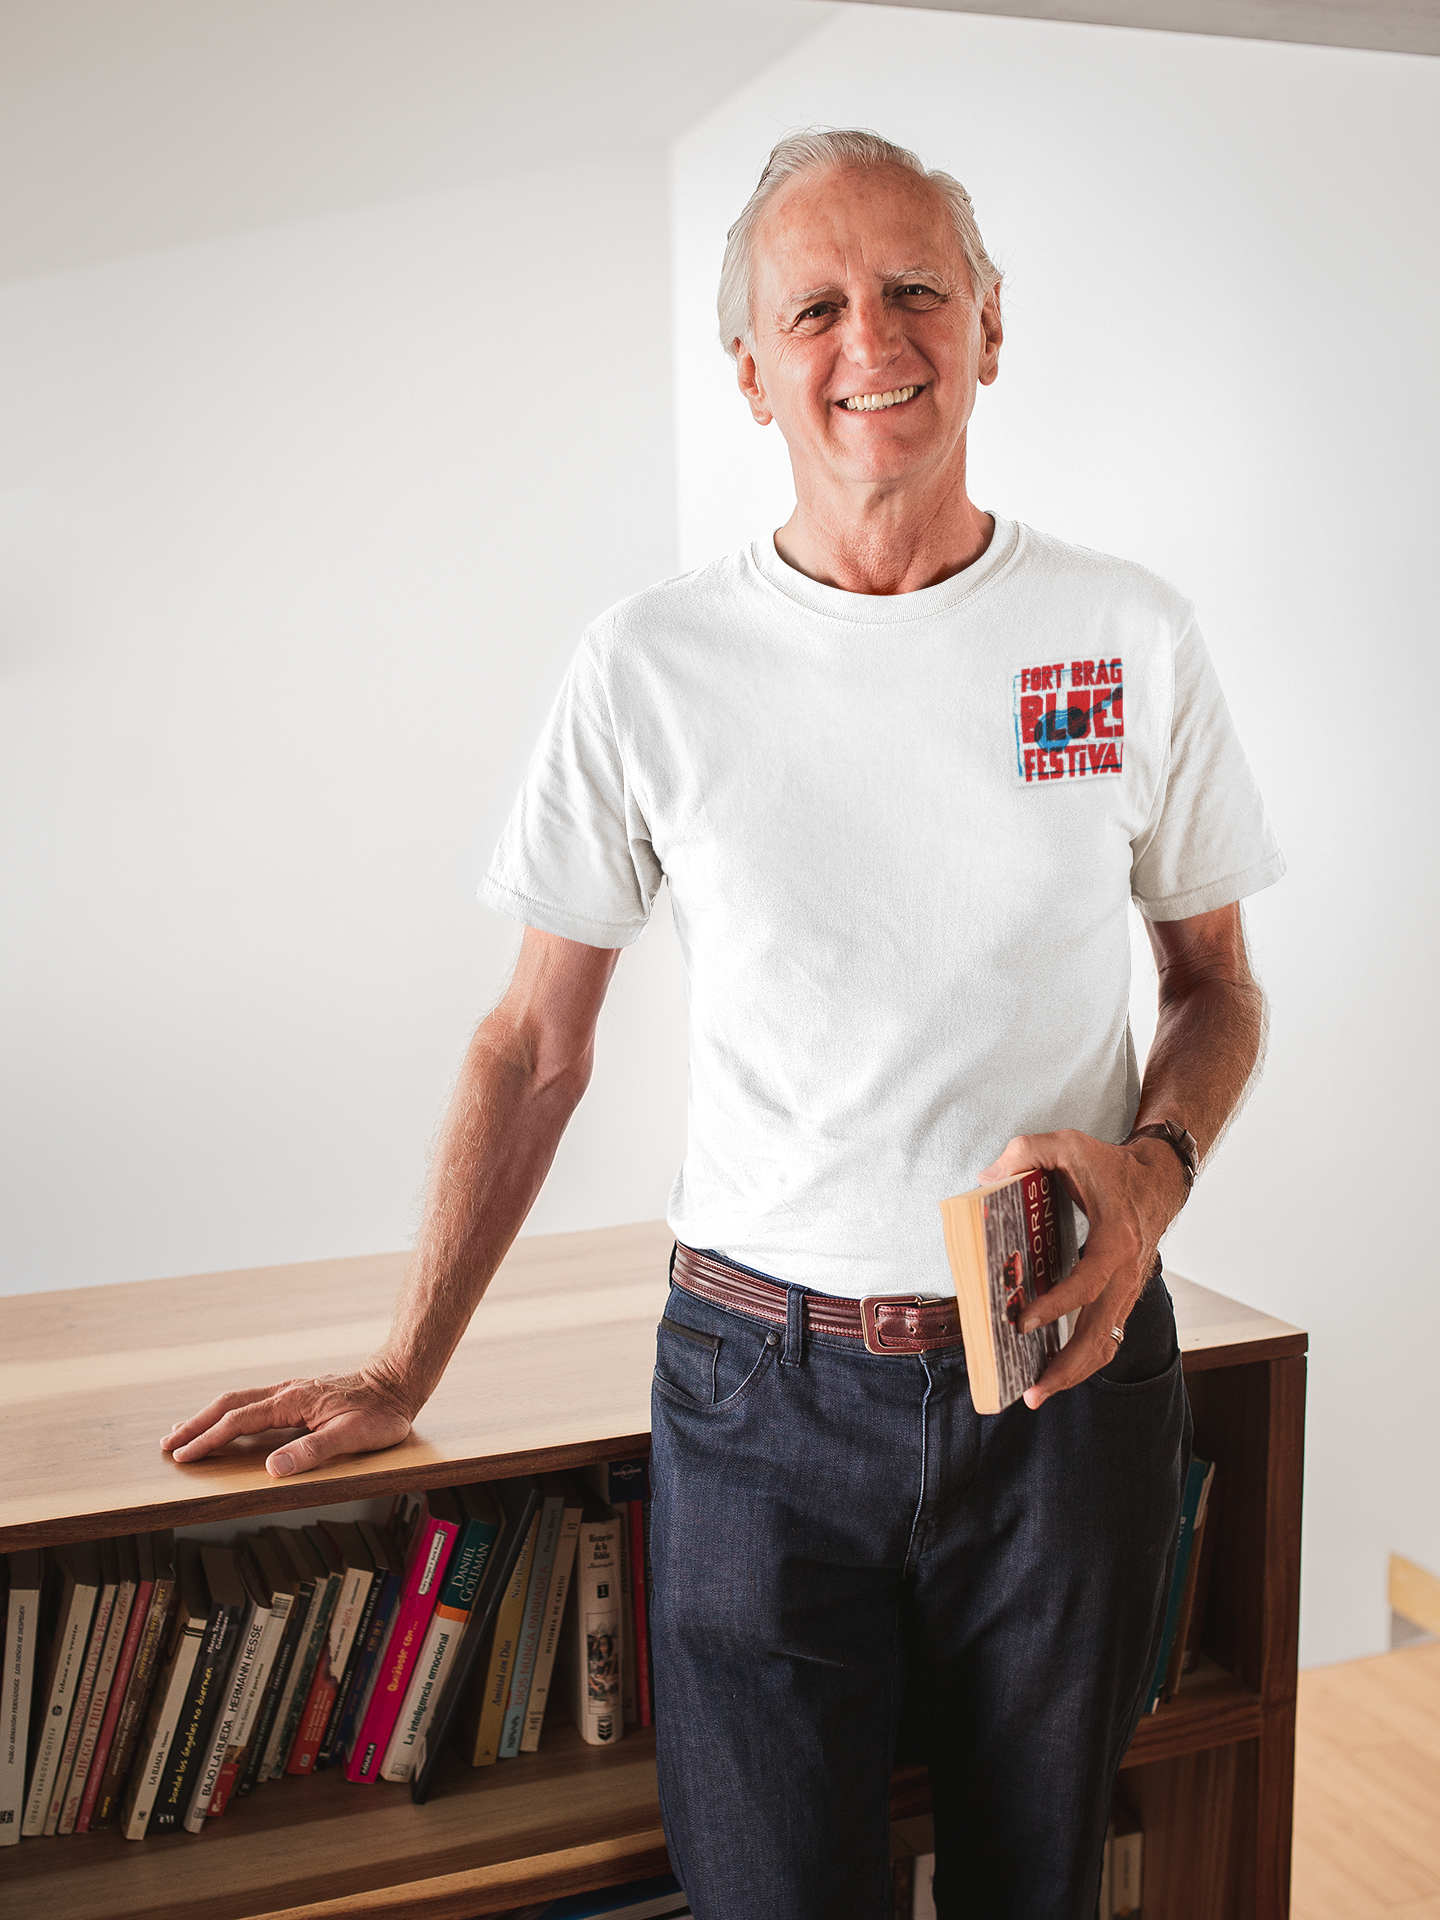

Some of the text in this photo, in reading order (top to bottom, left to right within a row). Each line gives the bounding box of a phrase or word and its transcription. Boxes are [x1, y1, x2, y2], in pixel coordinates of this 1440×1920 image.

[1021, 663, 1064, 693] FORT
[1028, 1181, 1045, 1277] DORIS
[1040, 1176, 1060, 1282] ESSING
[452, 1544, 476, 1587] DANIEL
[458, 1542, 490, 1603] GOLEMAN
[545, 1575, 565, 1654] HISTORIA DE CRISTO
[514, 1565, 549, 1706] DIOS NUNCA PARPADEA
[194, 1666, 214, 1705] duermen
[228, 1624, 262, 1712] HERMANN HESSE
[492, 1674, 505, 1706] Amistad
[500, 1639, 511, 1659] Dios
[403, 1632, 449, 1746] La inteligencia emocional
[76, 1738, 93, 1778] DIEGO
[89, 1690, 106, 1729] FRIDA
[192, 1708, 202, 1720] no
[215, 1719, 233, 1753] RUEDA
[174, 1758, 188, 1775] los
[210, 1753, 222, 1768] LA
[361, 1743, 376, 1774] AGUILAR
[149, 1776, 157, 1785] LA
[168, 1775, 183, 1805] Donde
[201, 1768, 217, 1797] BAJO
